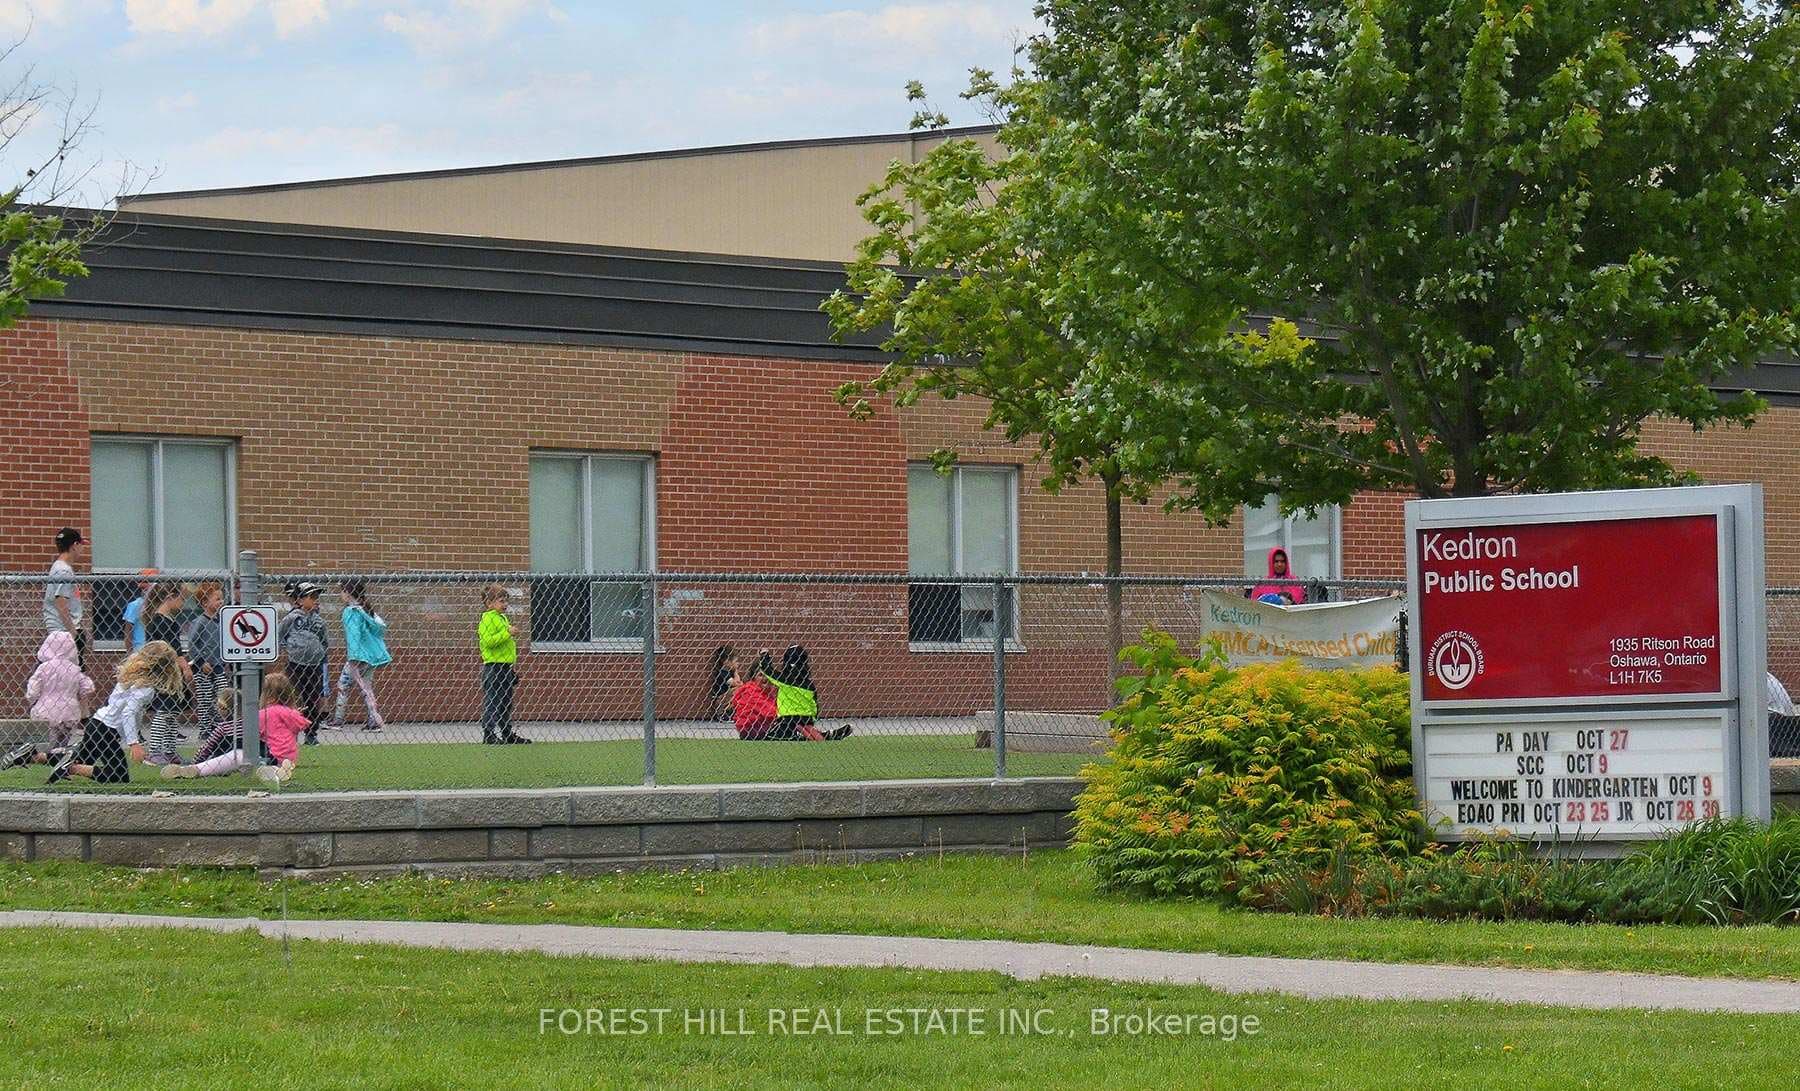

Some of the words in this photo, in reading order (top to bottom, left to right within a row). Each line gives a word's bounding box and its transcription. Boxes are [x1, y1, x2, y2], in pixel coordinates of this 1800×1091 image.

[1423, 532, 1517, 561] Kedron
[1424, 569, 1495, 594] Public
[1501, 565, 1579, 591] School
[1210, 604, 1262, 626] Kedron
[244, 647, 271, 655] DOGS
[1427, 646, 1437, 677] DURHAM
[1433, 630, 1458, 648] DISTRICT
[1458, 631, 1480, 651] SCHOOL
[1475, 649, 1485, 675] BOARD
[1609, 638, 1639, 651] 1935
[1642, 637, 1680, 650] Ritson
[1683, 635, 1715, 649] Road
[1610, 654, 1661, 668] Oshawa,
[1664, 652, 1707, 666] Ontario
[1610, 671, 1635, 684] L1H
[1638, 669, 1662, 683] 7K5
[1496, 732, 1513, 752] PA
[1522, 731, 1549, 752] DAY
[1577, 730, 1604, 750] OCT
[1609, 730, 1629, 751] 27
[1517, 755, 1544, 776] SCC
[1566, 753, 1594, 774] OCT
[1599, 753, 1608, 774] 9
[1451, 780, 1518, 800] WELCOME
[1526, 779, 1543, 799] TO
[1552, 777, 1658, 799] KINDERGARTEN
[1669, 776, 1696, 796] OCT
[1702, 775, 1712, 796] 9
[1502, 803, 1525, 823] PRI
[1534, 802, 1560, 822] OCT
[1567, 802, 1585, 822] 23
[1591, 801, 1609, 821] 25
[1617, 801, 1634, 821] JR
[1646, 801, 1673, 821] OCT
[1677, 800, 1695, 821] 28
[1702, 799, 1720, 820] 30
